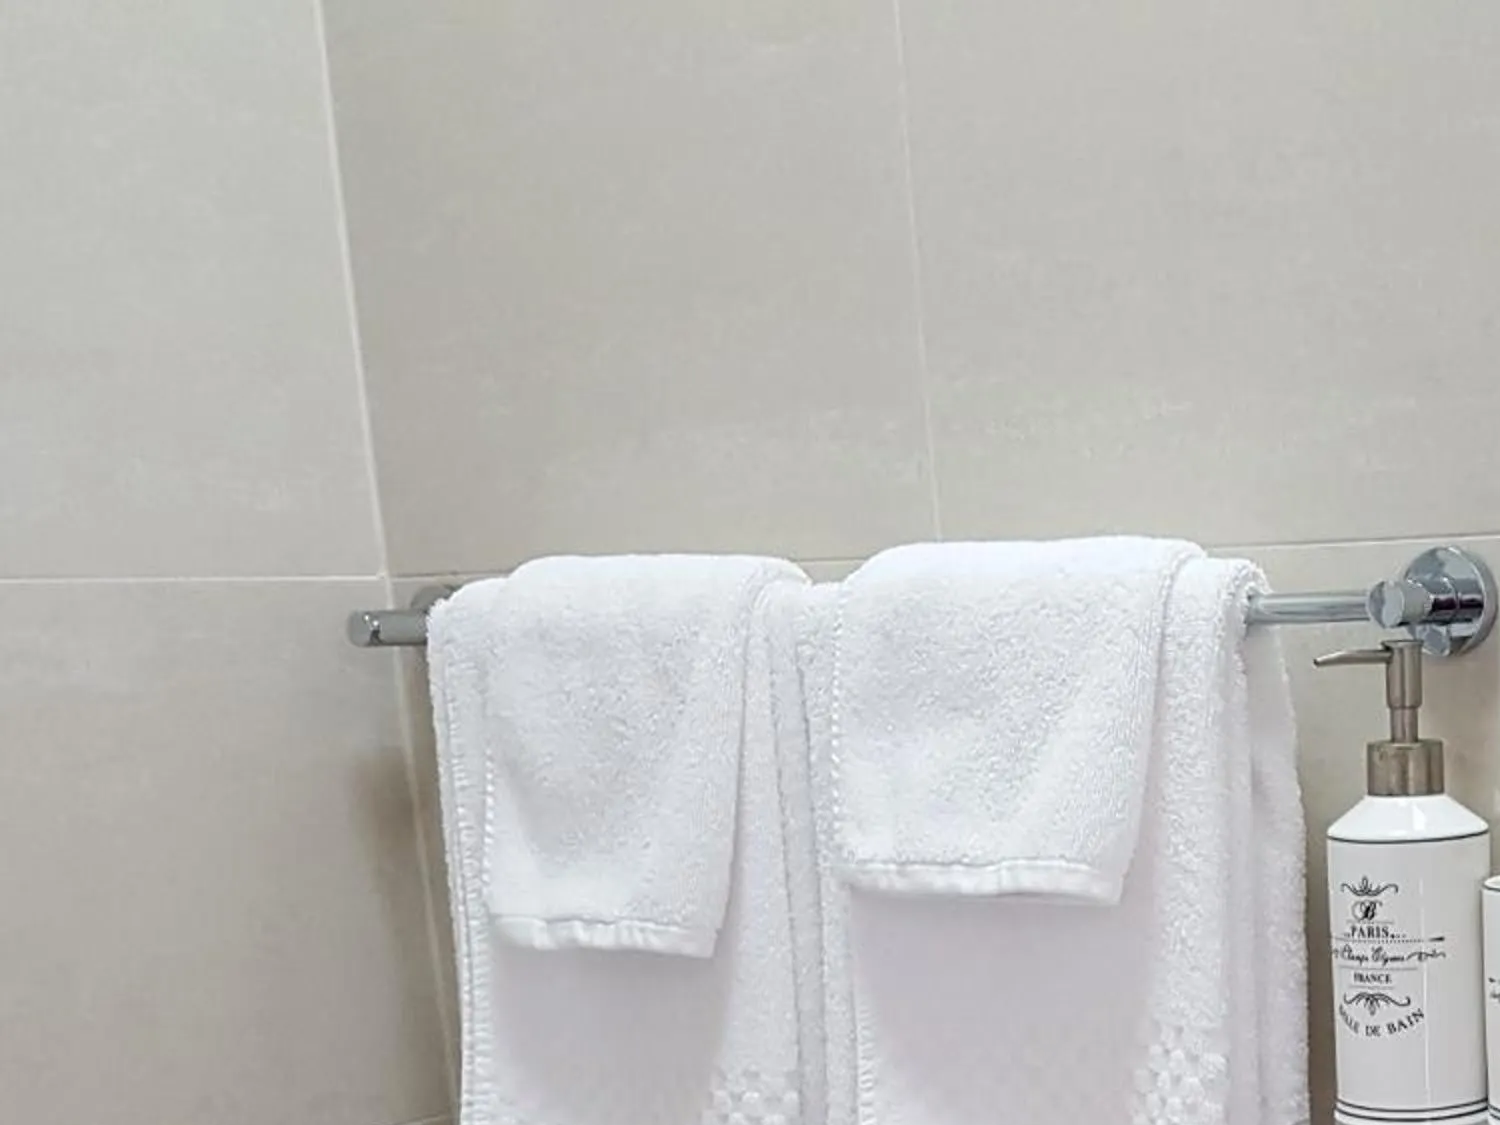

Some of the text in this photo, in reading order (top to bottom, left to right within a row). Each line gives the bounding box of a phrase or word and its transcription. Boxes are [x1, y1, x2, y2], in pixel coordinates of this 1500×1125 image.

[1350, 925, 1389, 938] PARIS
[1353, 973, 1392, 984] FRANCE
[1365, 1025, 1381, 1036] DE
[1386, 1008, 1424, 1034] BAIN
